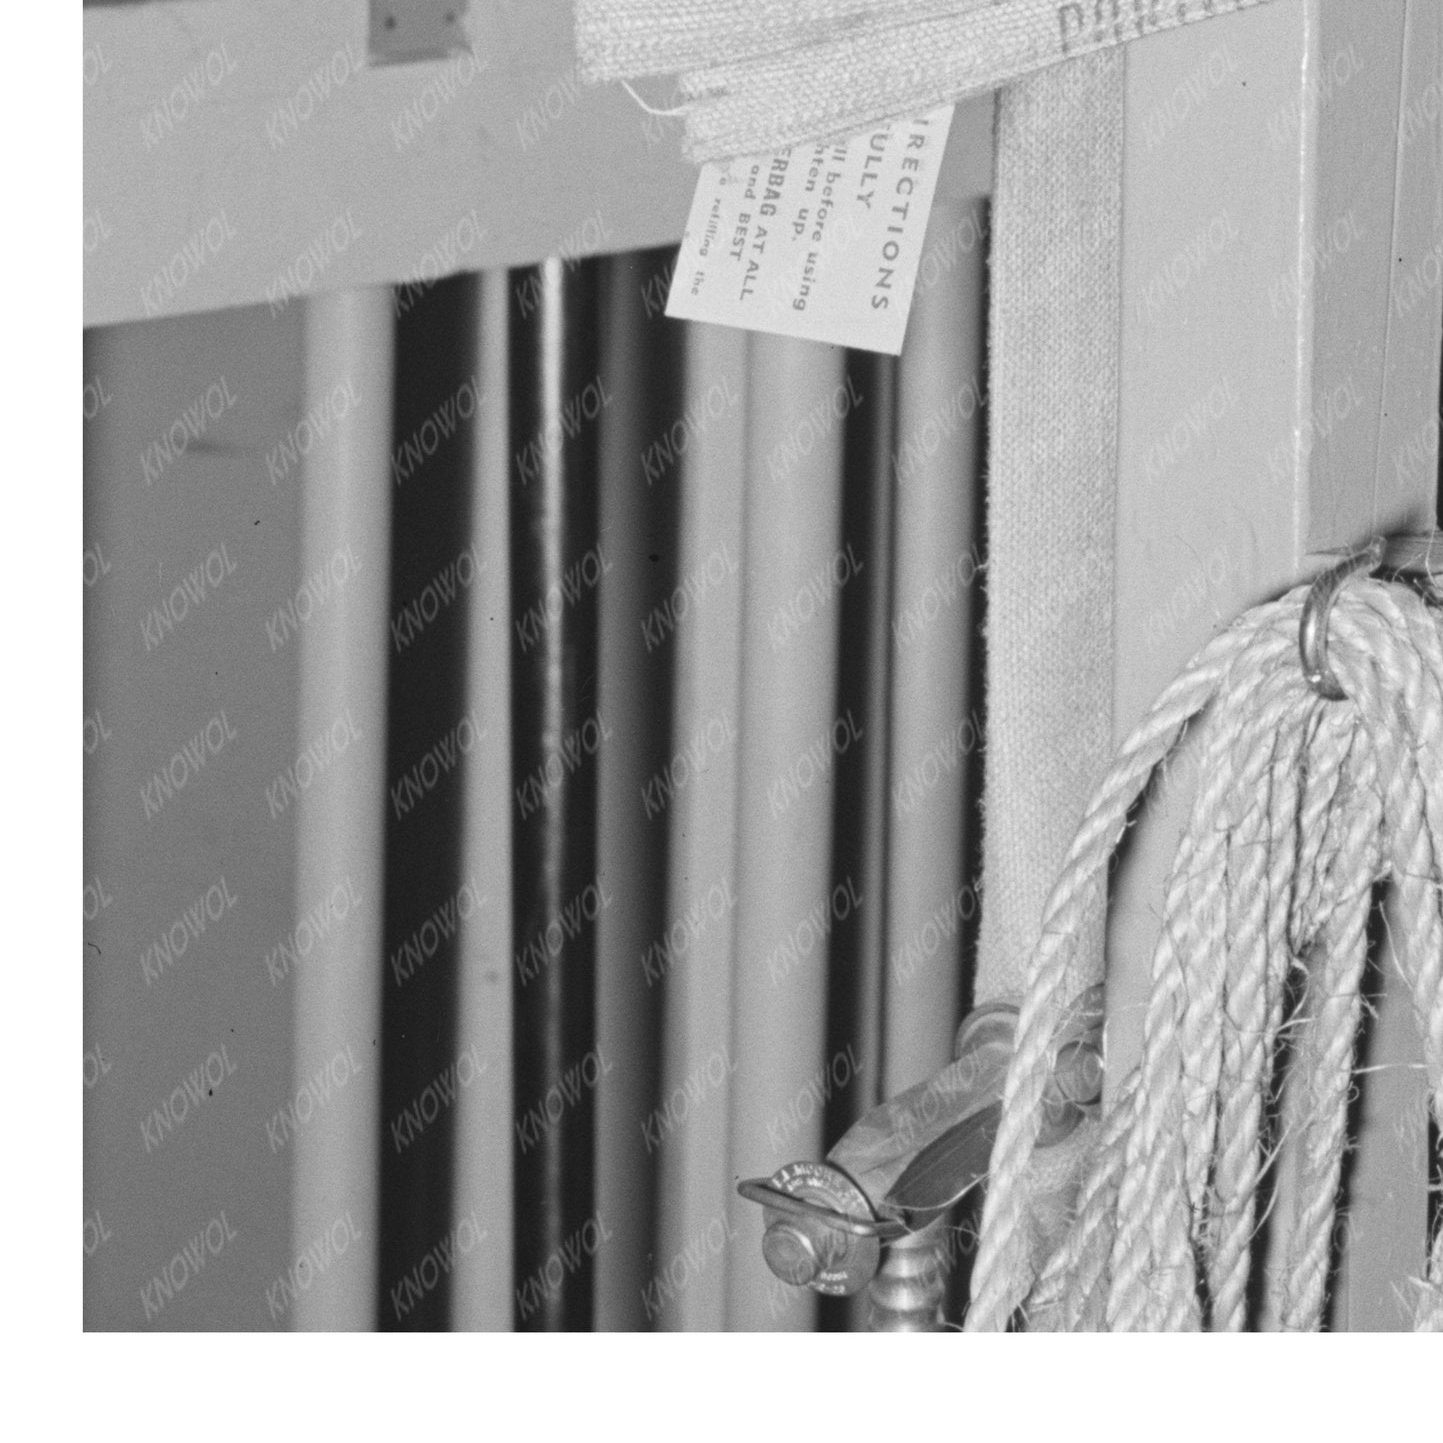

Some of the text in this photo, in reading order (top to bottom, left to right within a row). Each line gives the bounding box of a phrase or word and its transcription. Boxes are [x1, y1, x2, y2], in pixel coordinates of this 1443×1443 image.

[729, 165, 760, 262] and BEST
[810, 171, 842, 243] before
[753, 225, 770, 255] AT
[738, 258, 760, 302] ALL
[792, 251, 826, 312] using
